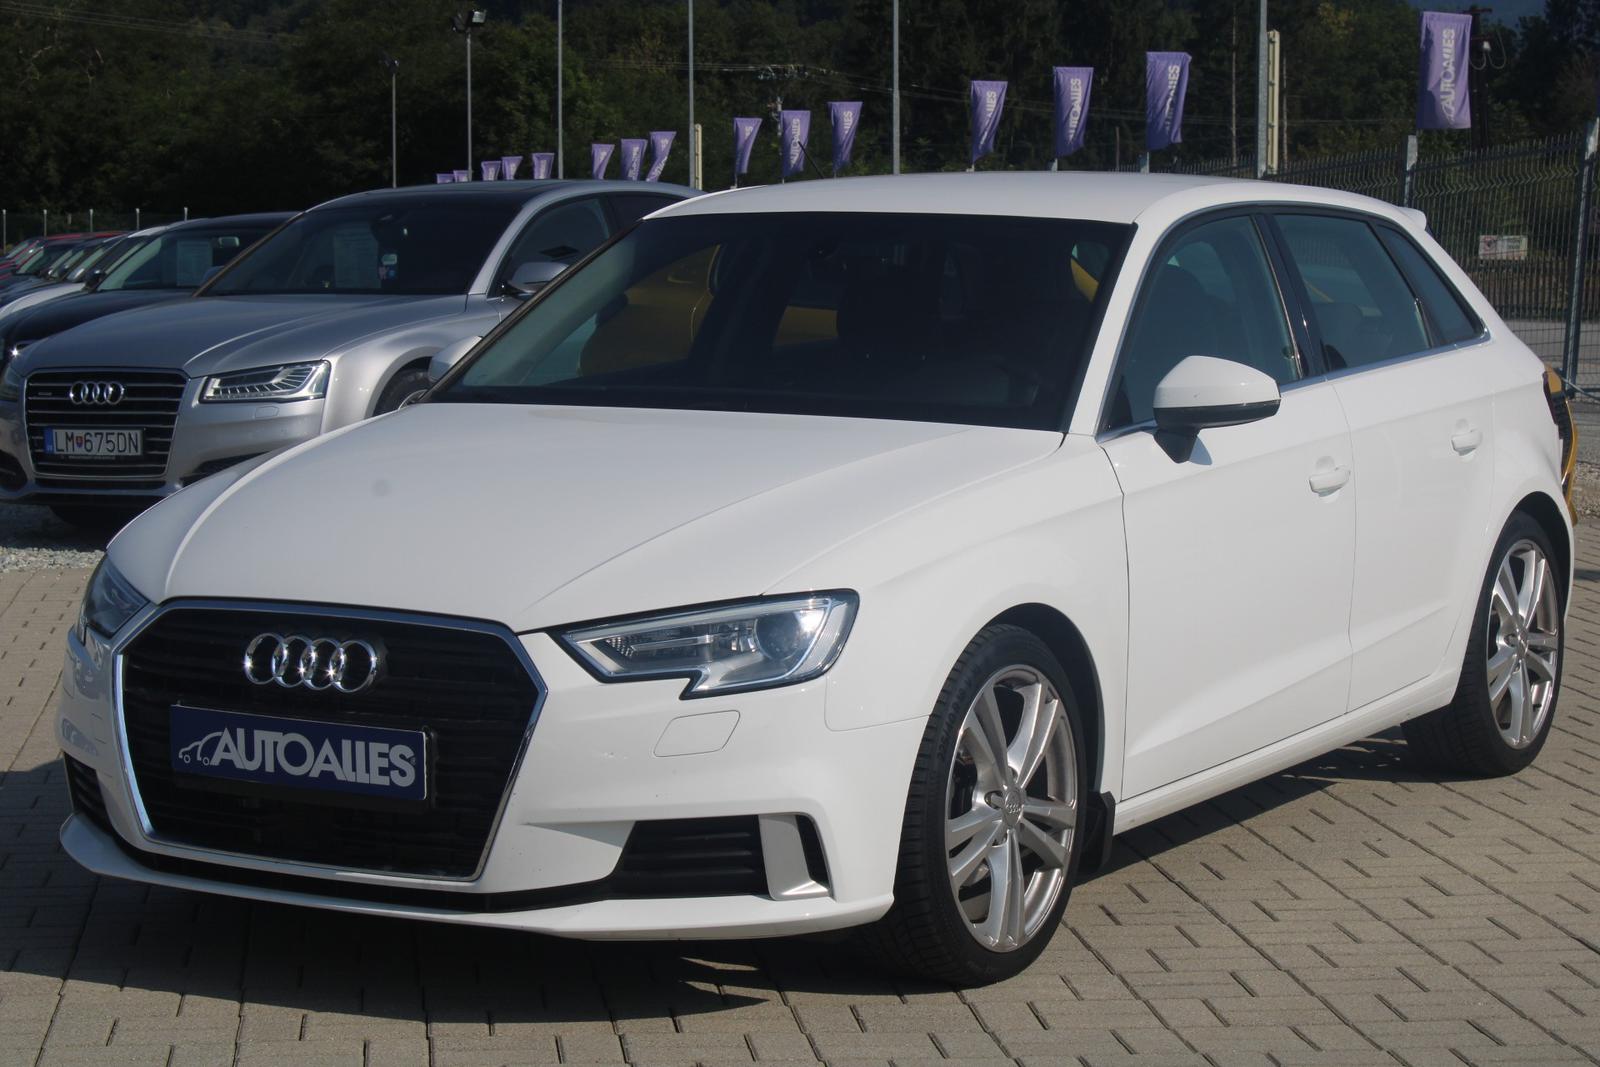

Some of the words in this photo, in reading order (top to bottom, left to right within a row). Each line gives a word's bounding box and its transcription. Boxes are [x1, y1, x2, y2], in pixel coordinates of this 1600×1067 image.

[55, 432, 75, 453] LM
[84, 432, 139, 453] 675DN
[210, 727, 416, 787] AUTOALLES
